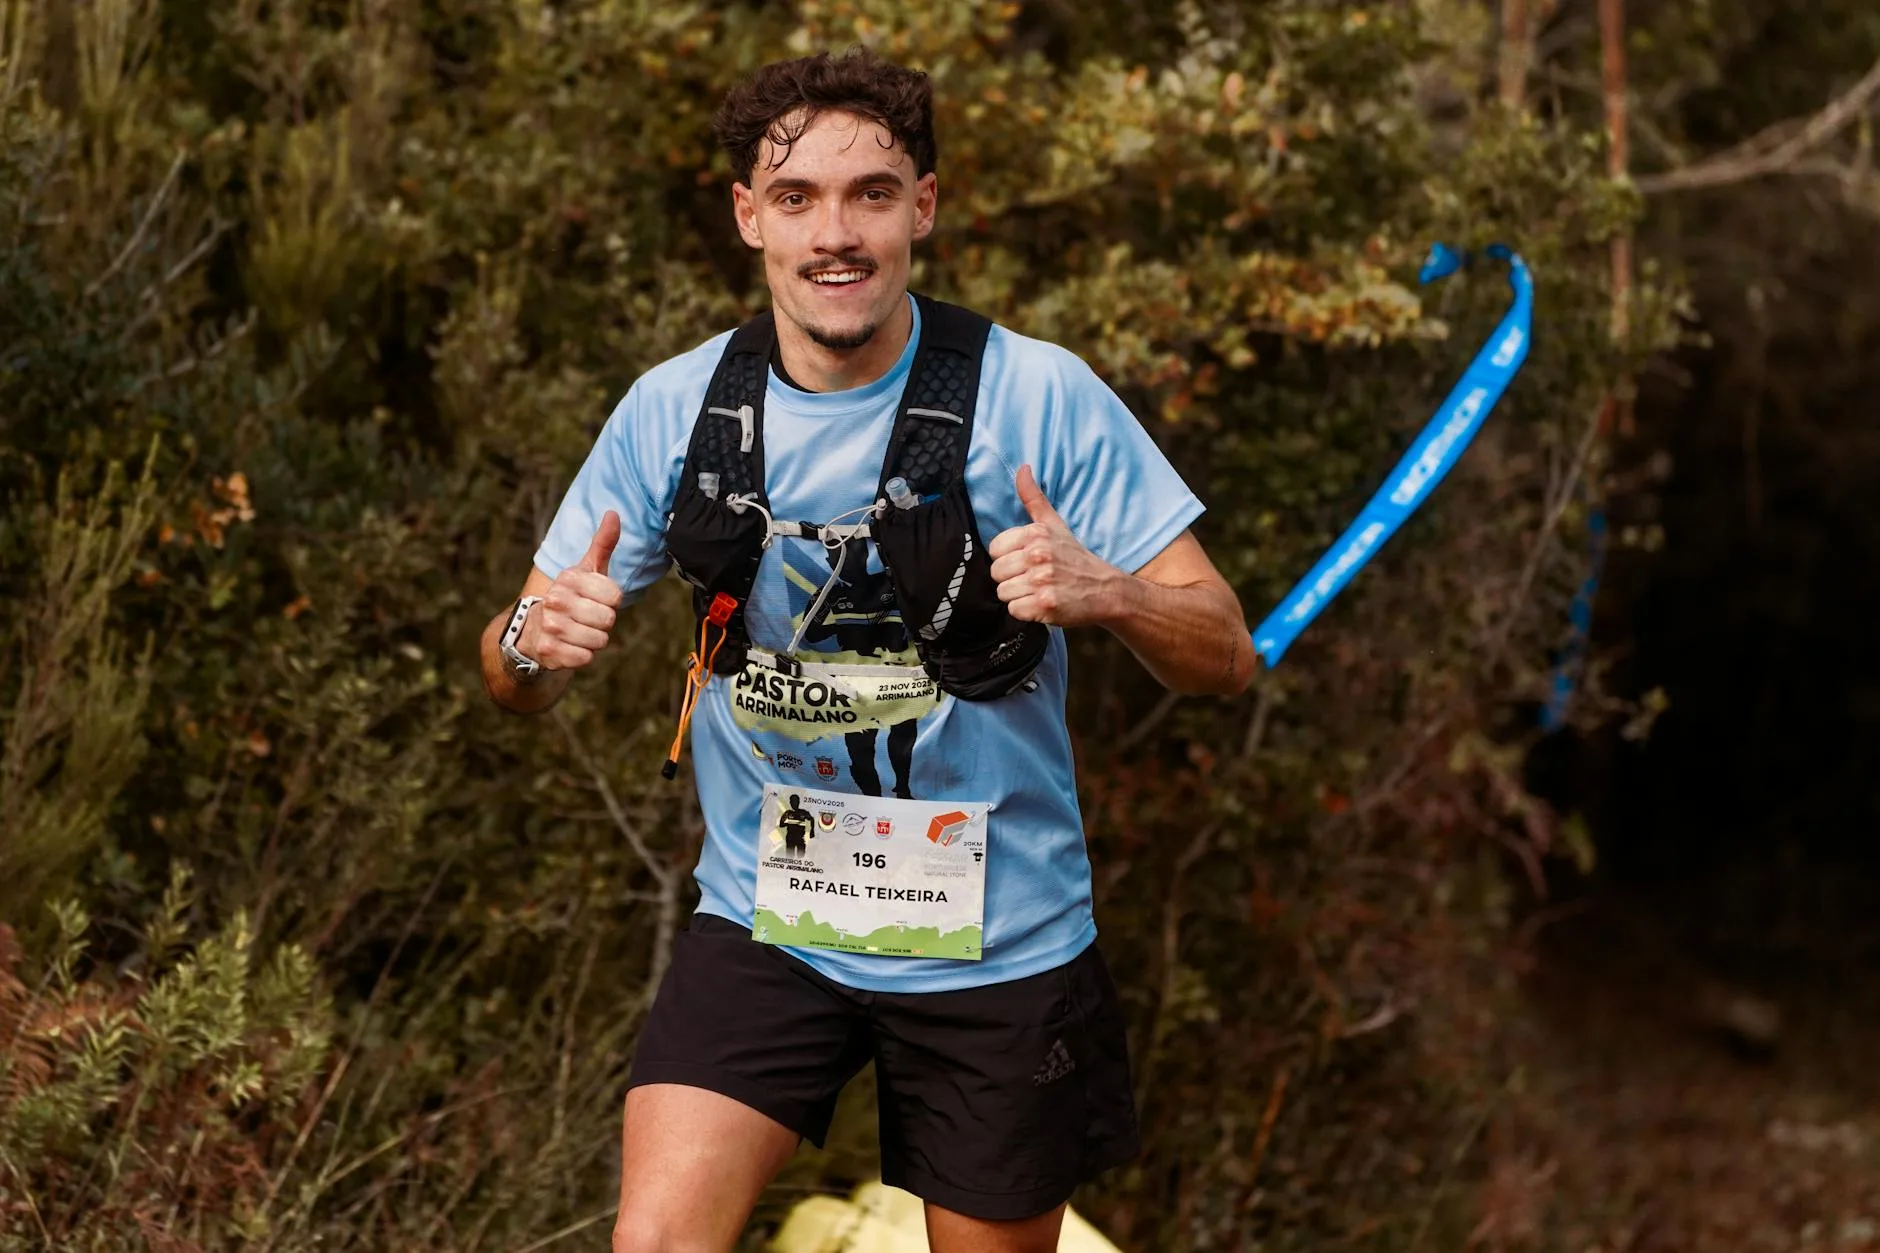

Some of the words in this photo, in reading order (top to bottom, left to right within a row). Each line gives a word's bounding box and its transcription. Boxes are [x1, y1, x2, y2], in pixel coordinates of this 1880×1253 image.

[736, 669, 852, 708] PASTOR
[878, 684, 889, 692] 23
[890, 683, 910, 691] NOV
[911, 679, 932, 689] 2025
[875, 688, 935, 702] ARRIMALANO
[736, 693, 857, 724] ARRIMALANO
[803, 796, 846, 808] 23NOV2025
[852, 852, 887, 869] 196
[789, 877, 860, 898] RAFAEL
[864, 886, 949, 903] TEIXEIRA
